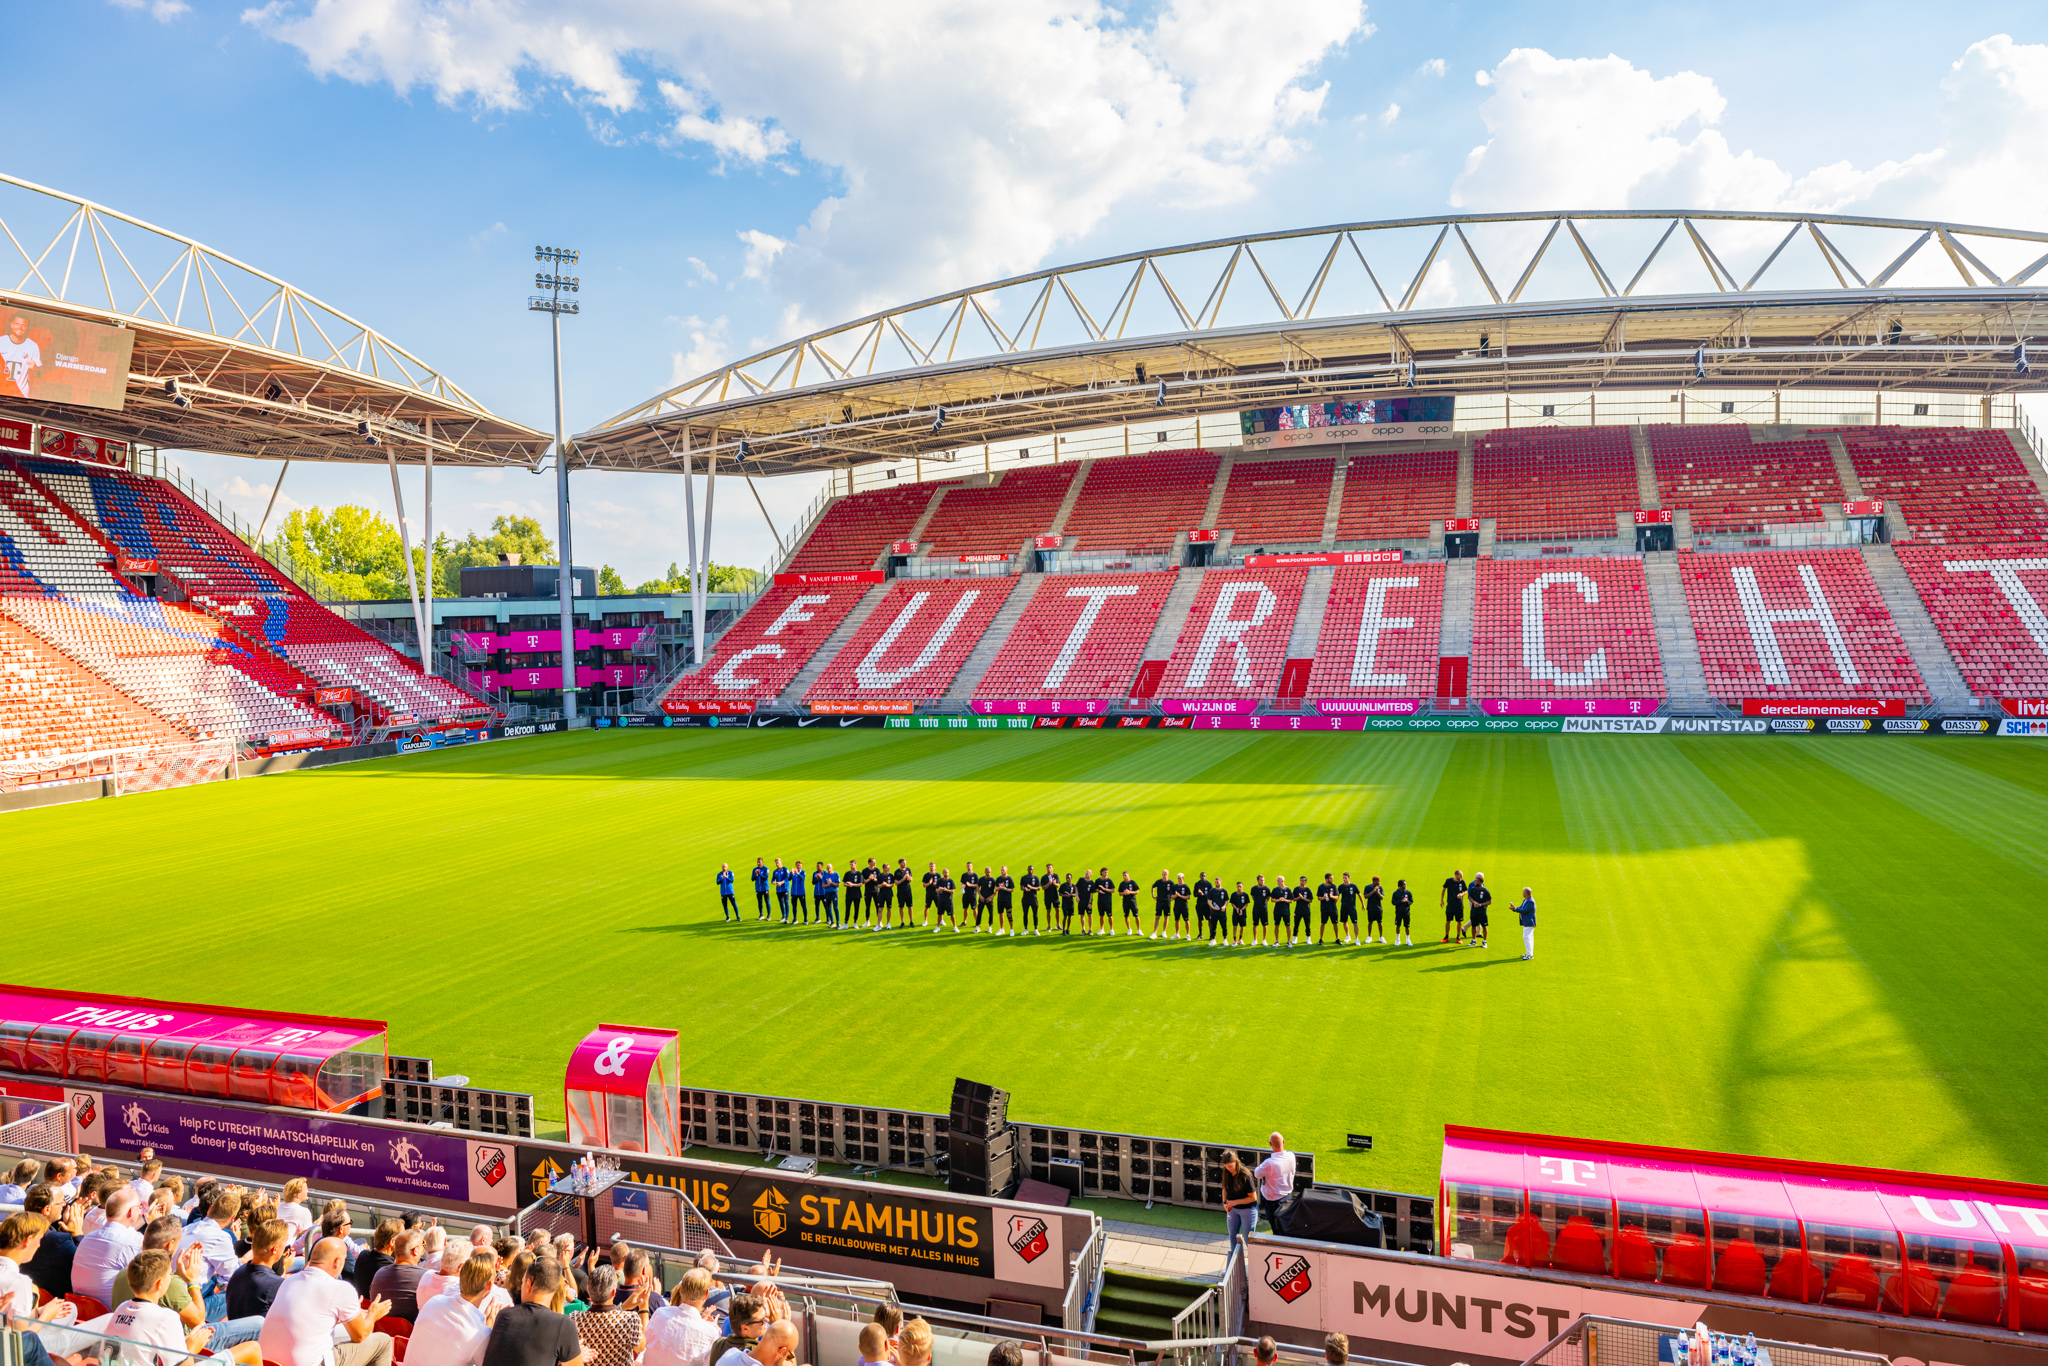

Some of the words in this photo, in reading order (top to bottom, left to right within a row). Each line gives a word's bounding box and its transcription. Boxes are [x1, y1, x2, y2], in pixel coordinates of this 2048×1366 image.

[55, 352, 79, 363] Django
[55, 360, 107, 374] WARMERDAM
[1246, 437, 1271, 446] oppo
[1284, 432, 1313, 442] oppo
[1327, 429, 1358, 439] oppo
[1371, 427, 1404, 436] oppo
[1418, 426, 1448, 434] oppo
[984, 554, 1001, 562] NESU
[763, 594, 831, 635] F
[712, 643, 787, 689] C
[667, 702, 675, 710] The
[675, 702, 689, 712] Valley
[698, 702, 706, 710] The
[706, 702, 721, 712] Valley
[737, 701, 752, 712] Valley
[815, 704, 831, 712] Only
[862, 704, 879, 712] Only
[1182, 703, 1200, 711] WIJ
[1202, 703, 1223, 711] ZIJN
[1224, 703, 1237, 711] DE
[1760, 704, 1879, 715] dereclamemakers
[890, 718, 910, 727] TOTO
[919, 718, 939, 727] TOTO
[948, 718, 968, 727] TOTO
[977, 718, 997, 727] TOTO
[1007, 718, 1028, 727] TOTO
[1039, 717, 1059, 726] Bud
[1078, 717, 1098, 726] Bud
[1122, 717, 1143, 726] Bud
[1163, 717, 1184, 726] Bud
[1371, 720, 1403, 728] oppo
[1409, 720, 1441, 728] oppo
[1447, 720, 1479, 728] oppo
[1485, 720, 1518, 729] oppo
[1525, 721, 1558, 729] oppo
[1567, 719, 1657, 731] MUNTSTAD
[1671, 720, 1767, 732] MUNTSTAD
[1774, 720, 1805, 728] DASSY
[1830, 720, 1861, 728] DASSY
[1887, 721, 1919, 729] DASSY
[1945, 721, 1978, 729] DASSY
[403, 739, 430, 750] NAPOLEON
[51, 1006, 175, 1031] THUIS
[77, 1096, 81, 1105] F
[77, 1097, 94, 1121] UTRECHT
[85, 1112, 92, 1122] C
[179, 1116, 202, 1131] Help
[203, 1119, 216, 1131] FC
[218, 1122, 262, 1137] UTRECHT
[263, 1127, 359, 1151] MAATSCHAPPELIJK
[360, 1143, 375, 1153] en
[119, 1137, 174, 1151] www.IT4kids.com
[190, 1134, 225, 1148] doneer
[227, 1137, 237, 1152] je
[238, 1140, 310, 1160] afgeschreven
[312, 1150, 364, 1168] hardware
[482, 1150, 488, 1160] F
[480, 1150, 504, 1178] UTRECHT
[492, 1168, 501, 1179] C
[385, 1175, 450, 1191] www.IT4kids.com
[800, 1194, 980, 1249] STAMHUIS
[1016, 1219, 1024, 1232] F
[1013, 1221, 1045, 1253] UTRECHT
[800, 1231, 814, 1243] DE
[815, 1233, 887, 1253] RETAILBOUWER
[889, 1244, 908, 1256] MET
[911, 1247, 942, 1261] ALLES
[943, 1252, 954, 1263] IN
[956, 1254, 980, 1267] HUIS
[1030, 1241, 1041, 1254] C
[1275, 1257, 1283, 1270] F
[1270, 1258, 1308, 1292] UTRECHT
[1291, 1280, 1302, 1293] C
